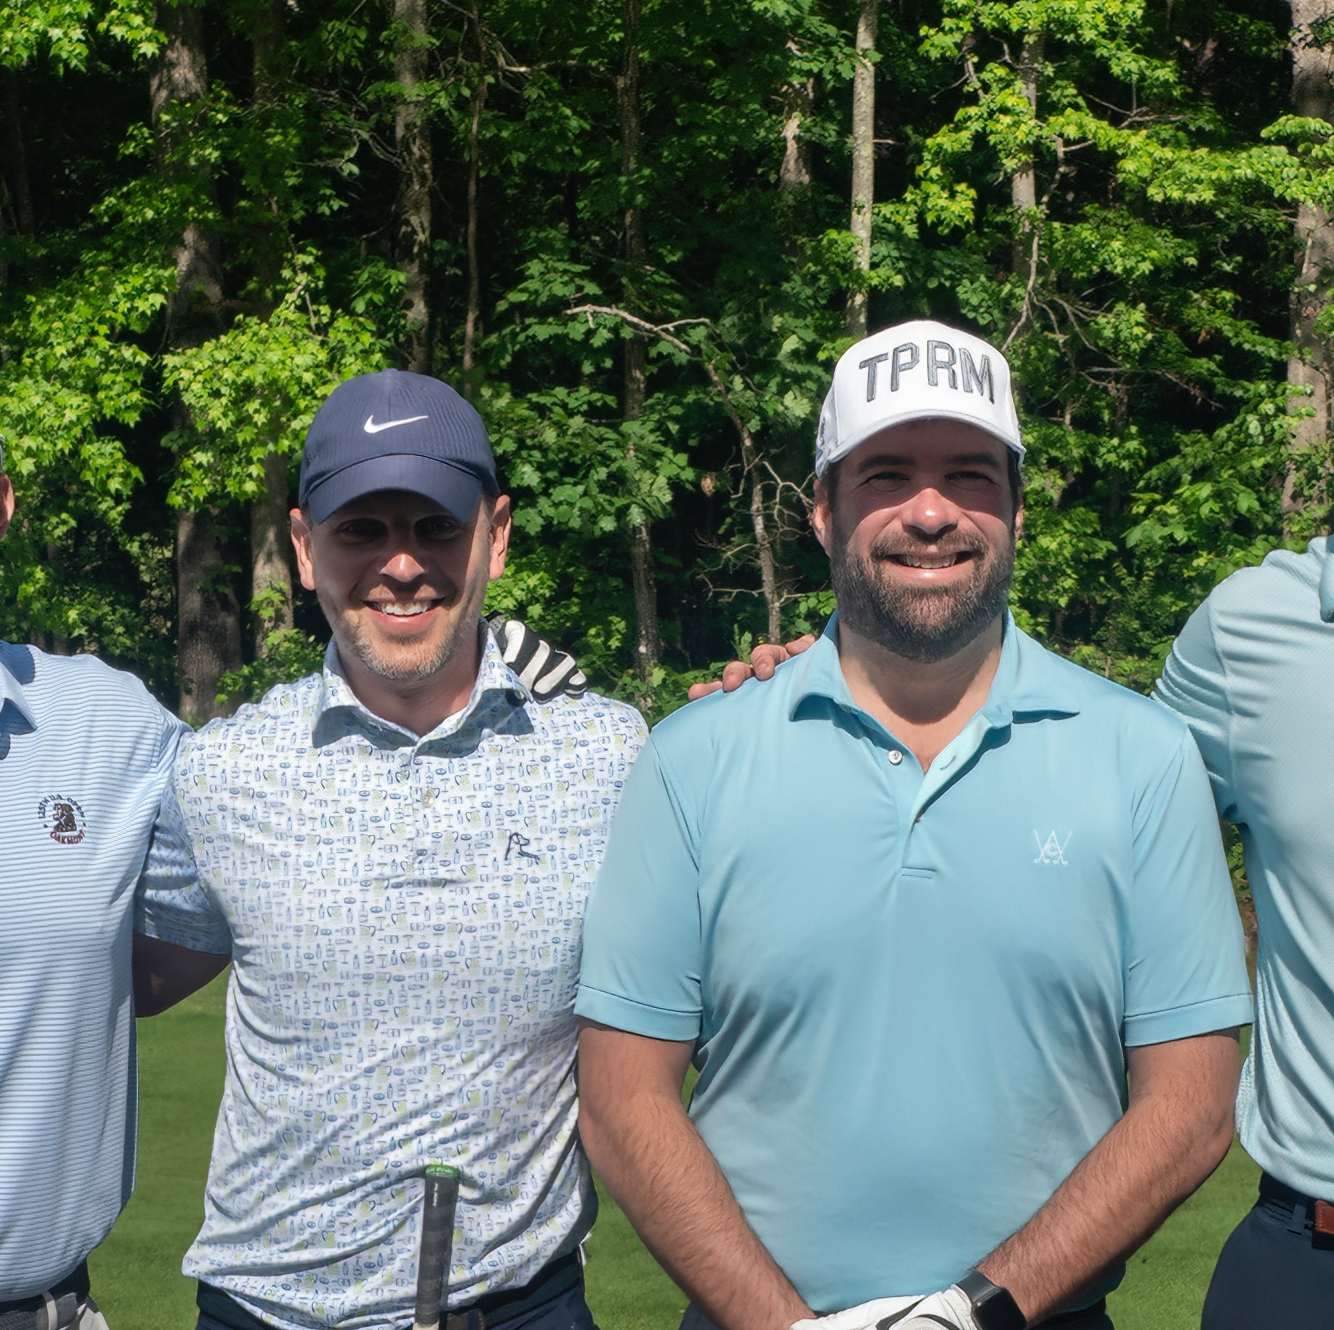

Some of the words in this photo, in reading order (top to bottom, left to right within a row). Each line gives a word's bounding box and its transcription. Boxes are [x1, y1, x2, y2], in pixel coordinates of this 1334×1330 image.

[859, 339, 995, 405] TPRM
[66, 797, 86, 818] OPEN
[50, 829, 86, 845] OAKMONT
